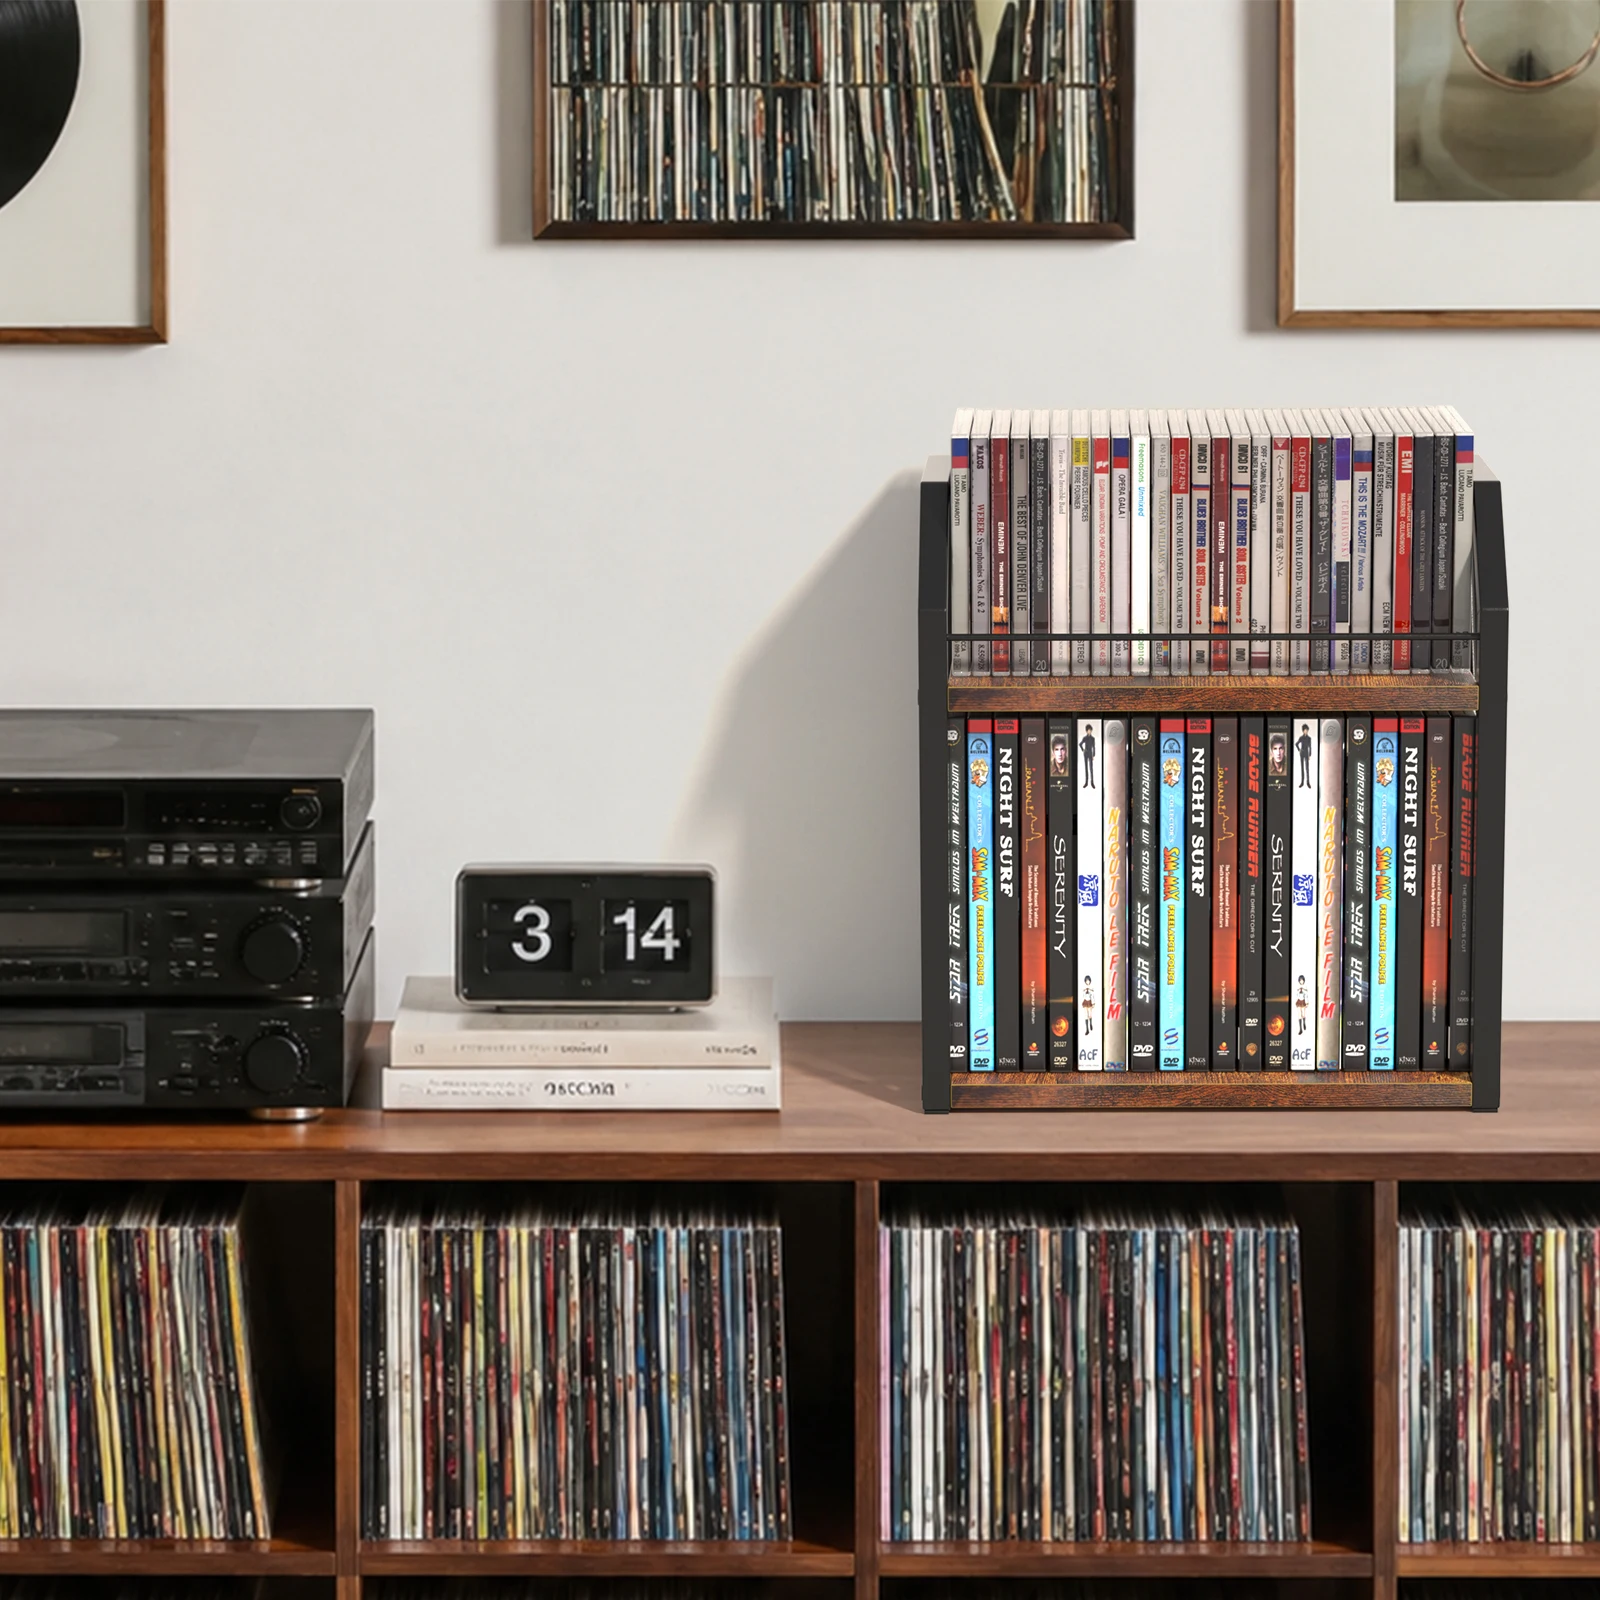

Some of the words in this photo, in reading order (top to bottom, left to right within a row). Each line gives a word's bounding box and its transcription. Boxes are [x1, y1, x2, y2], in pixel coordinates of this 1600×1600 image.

[1377, 462, 1386, 472] FÜR
[1402, 450, 1412, 473] EMI
[1359, 478, 1367, 493] THIS
[1017, 496, 1027, 510] THE
[1196, 499, 1206, 518] BLUES
[1237, 498, 1247, 518] BLUES
[1359, 505, 1367, 518] THE
[1017, 511, 1027, 528] BEST
[1237, 519, 1247, 546] BROTHER
[1017, 531, 1027, 540] OF
[1196, 520, 1206, 547] BROTHER
[975, 538, 985, 578] Symphonies
[1017, 542, 1027, 561] JOHN
[1196, 549, 1206, 564] SOUL
[1237, 548, 1247, 563] SOUL
[1017, 564, 1027, 594] DENVER
[1196, 566, 1206, 586] SISTER
[1237, 565, 1247, 585] SISTER
[1017, 595, 1027, 611] LIVE
[1248, 734, 1260, 792] BLADE
[1461, 733, 1472, 792] BLADE
[1000, 748, 1013, 828] NIGHT
[1192, 748, 1204, 828] NIGHT
[1404, 747, 1418, 827] NIGHT
[1248, 797, 1260, 877] RUNNER
[1460, 797, 1471, 877] RUNNER
[972, 847, 988, 871] SAM
[1000, 835, 1013, 898] SURF
[1108, 807, 1121, 908] NARUTO
[1164, 847, 1179, 871] SAM
[1192, 835, 1204, 897] SURF
[1324, 806, 1337, 907] NARUTO
[1403, 835, 1416, 896] SURF
[972, 876, 988, 902] MAX
[1053, 835, 1066, 958] SERENITY
[1164, 876, 1179, 901] MAX
[1271, 834, 1283, 958] SERENITY
[511, 905, 552, 961] 3
[613, 906, 681, 961] 14
[1109, 915, 1120, 947] LE
[1324, 914, 1334, 946] LE
[1107, 953, 1122, 1021] FILM
[1321, 953, 1336, 1019] FILM
[1079, 1049, 1098, 1060] AcF
[1292, 1049, 1311, 1060] AcF
[1345, 1044, 1366, 1056] DVD
